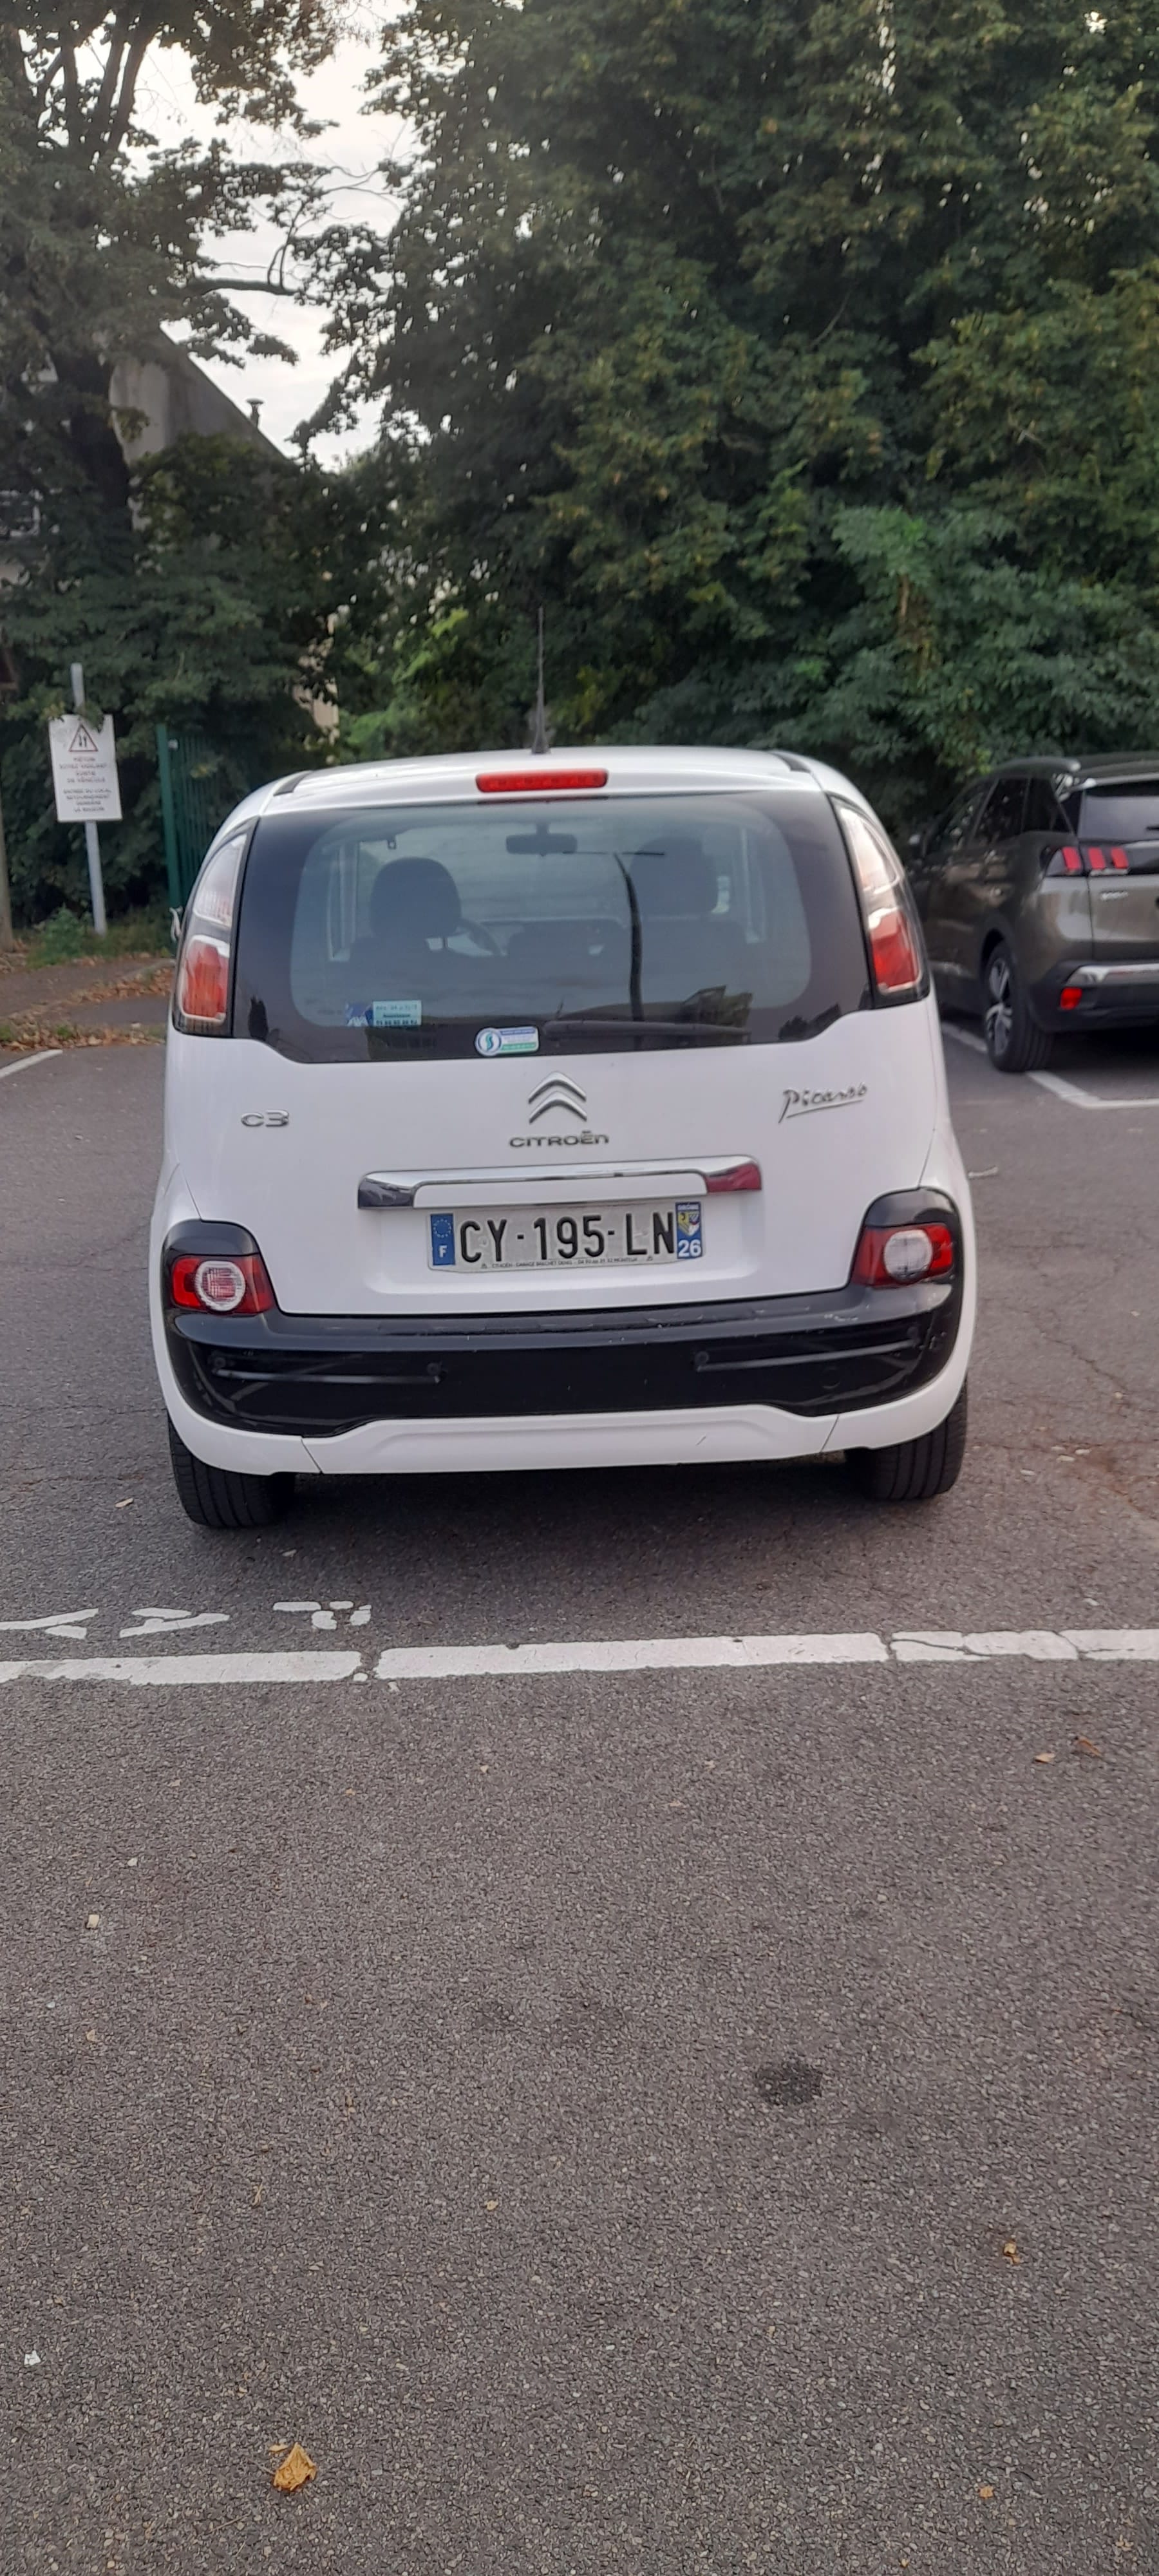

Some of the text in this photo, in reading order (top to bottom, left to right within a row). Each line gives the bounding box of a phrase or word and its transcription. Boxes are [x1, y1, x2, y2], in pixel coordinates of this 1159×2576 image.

[778, 1082, 868, 1124] Picasso
[241, 1110, 290, 1128] C3
[509, 1130, 609, 1148] CITROËN
[438, 1245, 448, 1258] F
[678, 1239, 702, 1258] 26
